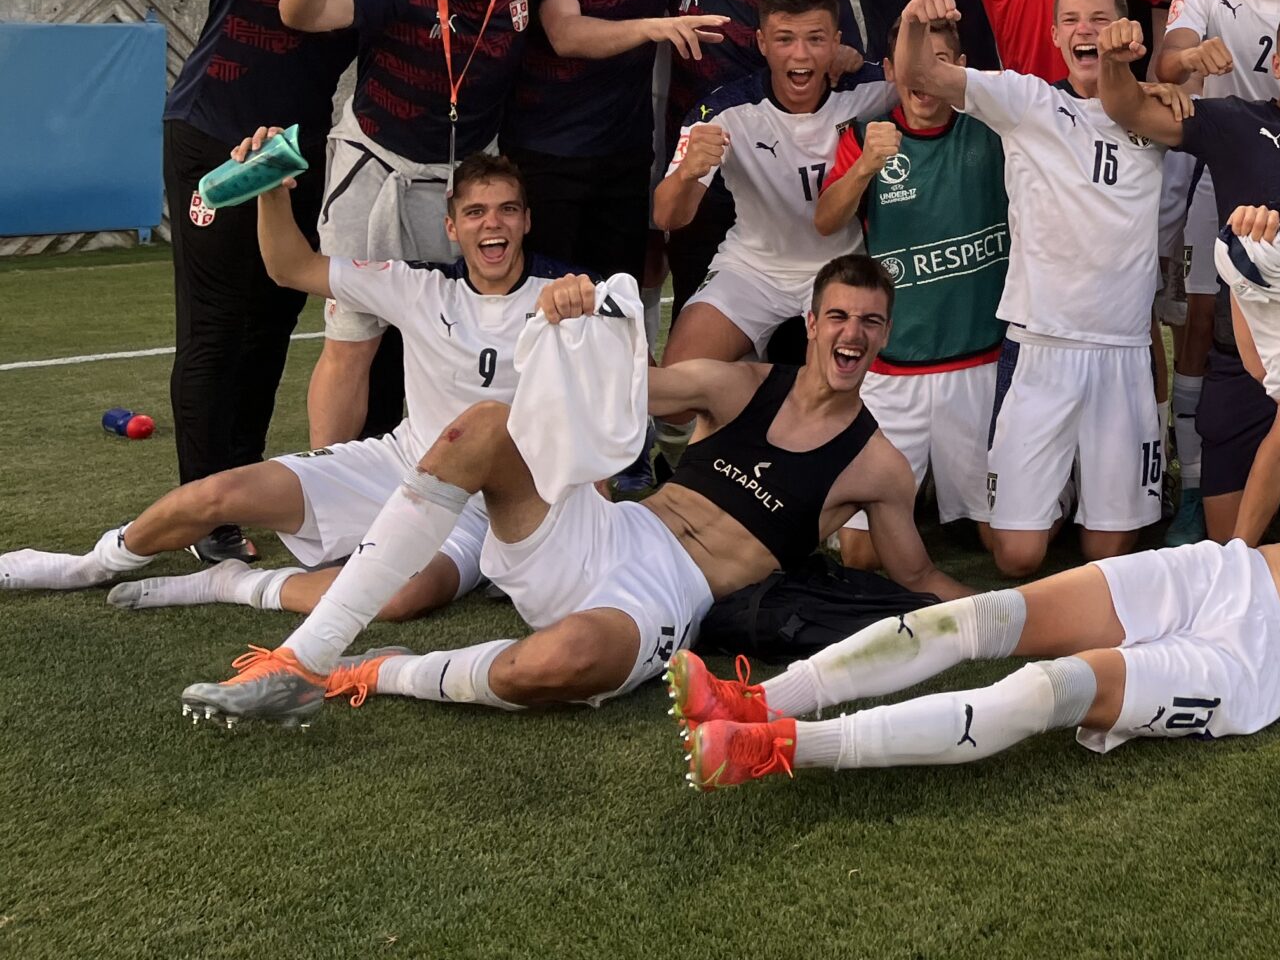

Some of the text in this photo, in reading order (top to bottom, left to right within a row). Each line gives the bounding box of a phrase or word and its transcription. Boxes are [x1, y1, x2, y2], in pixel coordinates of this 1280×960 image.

[1253, 35, 1274, 74] 2
[798, 162, 826, 201] 17
[1092, 140, 1118, 186] 15
[913, 231, 1007, 276] RESPECT
[479, 348, 498, 388] 9
[713, 458, 785, 513] CATAPULT
[1142, 440, 1161, 486] 15
